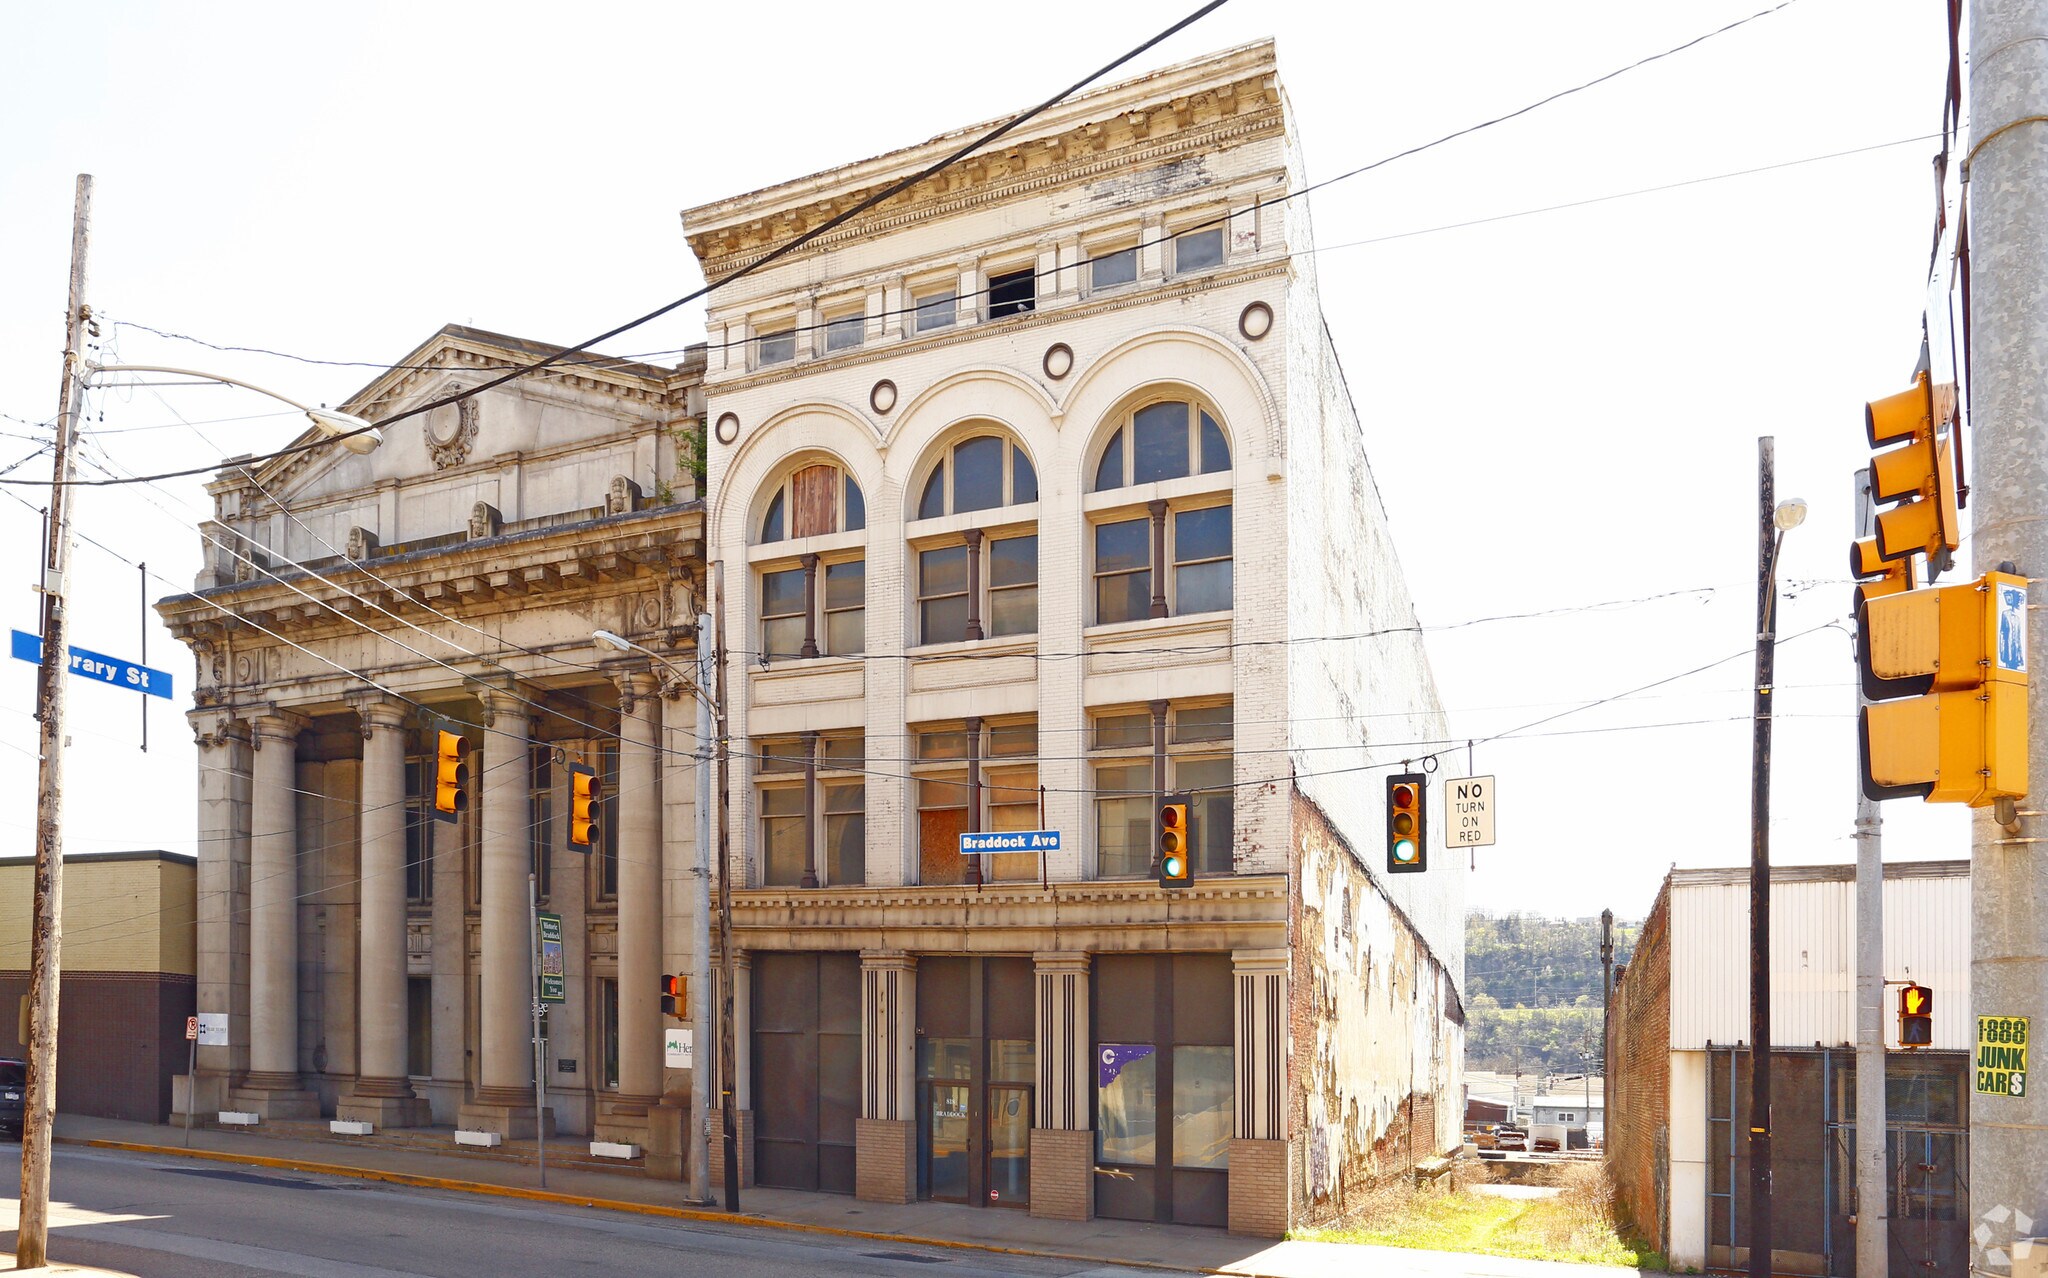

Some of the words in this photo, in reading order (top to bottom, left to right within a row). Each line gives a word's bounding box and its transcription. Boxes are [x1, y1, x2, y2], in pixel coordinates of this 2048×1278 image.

[126, 666, 149, 688] St
[1457, 784, 1482, 799] NO
[1456, 801, 1485, 813] TURN
[1462, 816, 1478, 827] ON
[963, 836, 1026, 849] Braddock
[1031, 834, 1058, 847] Ave
[1459, 830, 1481, 842] RED
[543, 930, 560, 940] Braddock
[1977, 1045, 2025, 1071] JUNK
